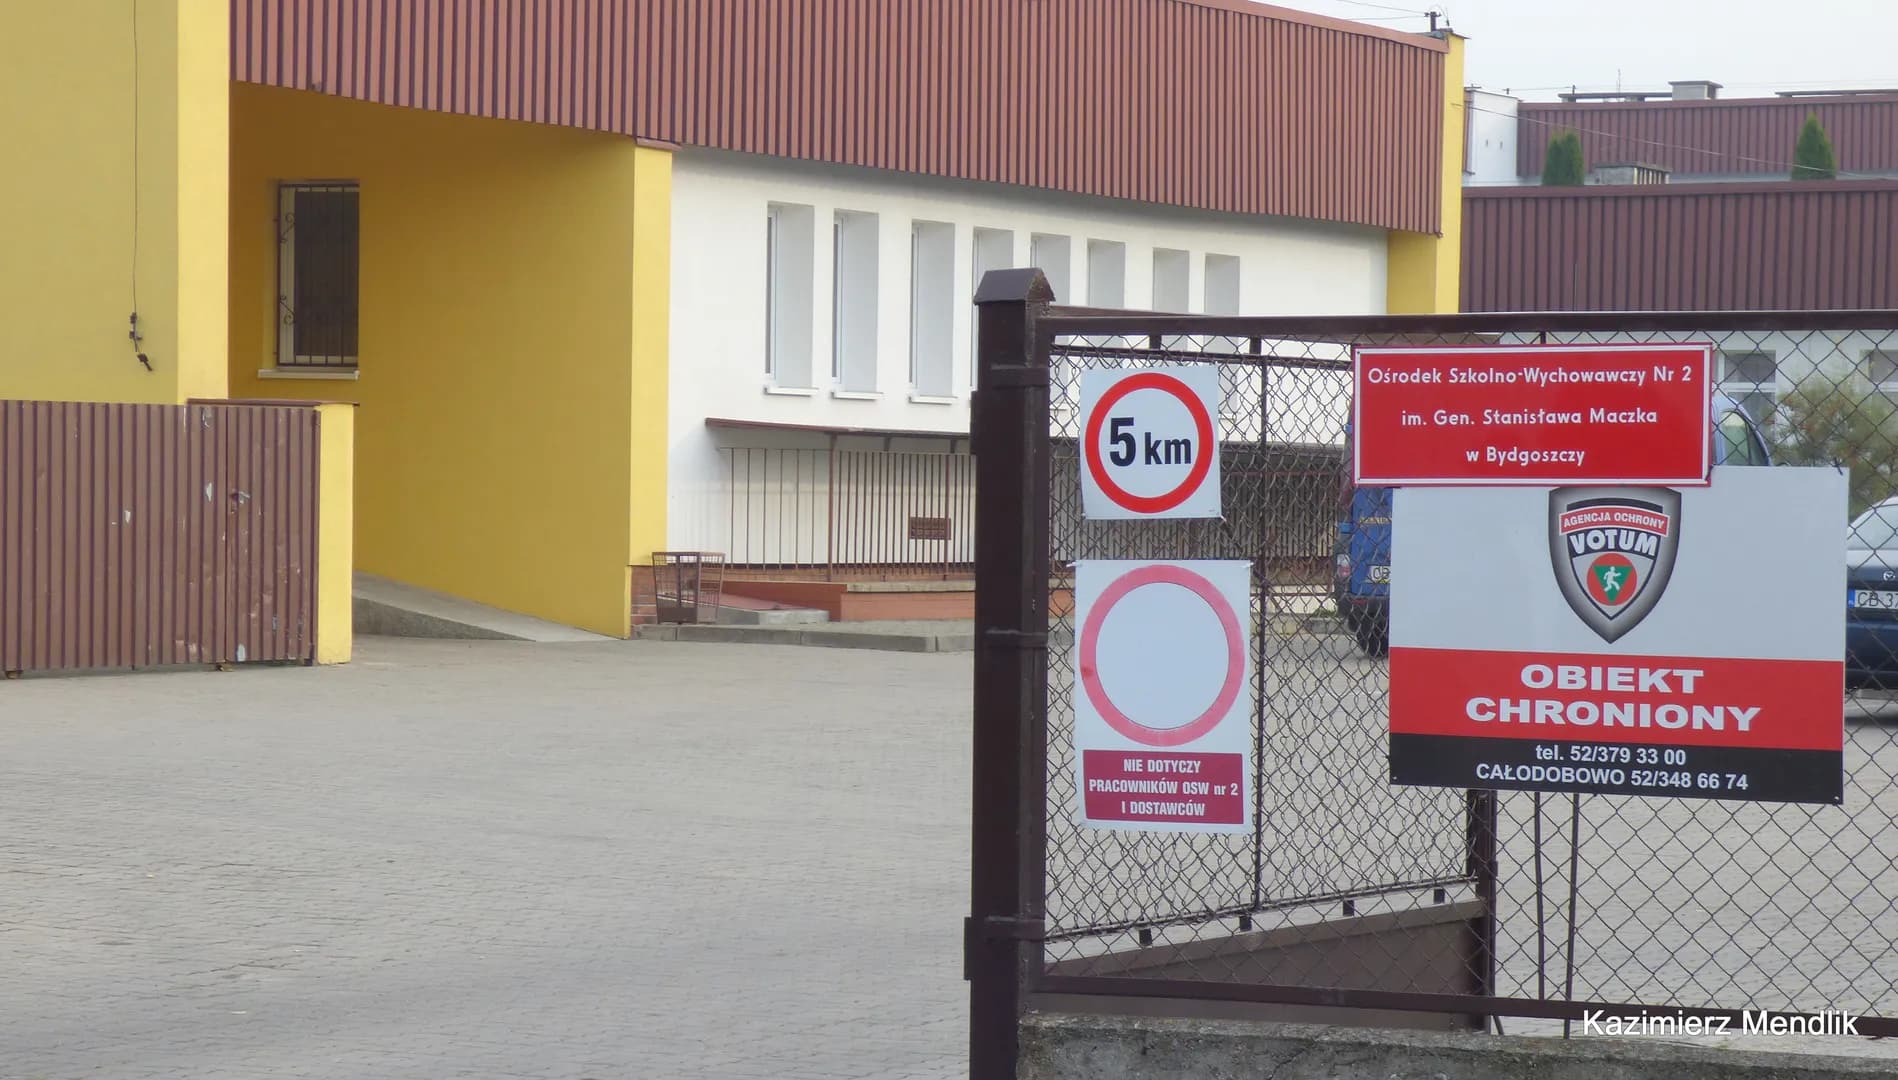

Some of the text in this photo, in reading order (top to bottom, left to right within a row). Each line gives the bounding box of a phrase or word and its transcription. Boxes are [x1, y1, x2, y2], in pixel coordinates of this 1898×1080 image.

[1367, 366, 1692, 387] Ośrodek Szkolno-Wychowawczy Nr 2
[1401, 407, 1658, 426] im. Gen. Stanisława Maczka
[1109, 417, 1192, 467] 5 km
[1466, 446, 1585, 466] w Bydgoszczy
[1563, 512, 1665, 529] AGENCJA OCHRONY
[1569, 529, 1658, 556] VOTUM
[1520, 664, 1704, 694] OBIEKT
[1465, 697, 1761, 732] CHRONIONY
[1535, 745, 1686, 766] tel. 52/379 33 00
[1123, 759, 1201, 774] NIE DOTYCZY
[1476, 763, 1748, 791] CAŁODOBOWO 52/348 66 74
[1089, 777, 1239, 796] PRACOWNIKÓW OSW nr 2
[1121, 800, 1205, 816] I DOSTAWCÓW
